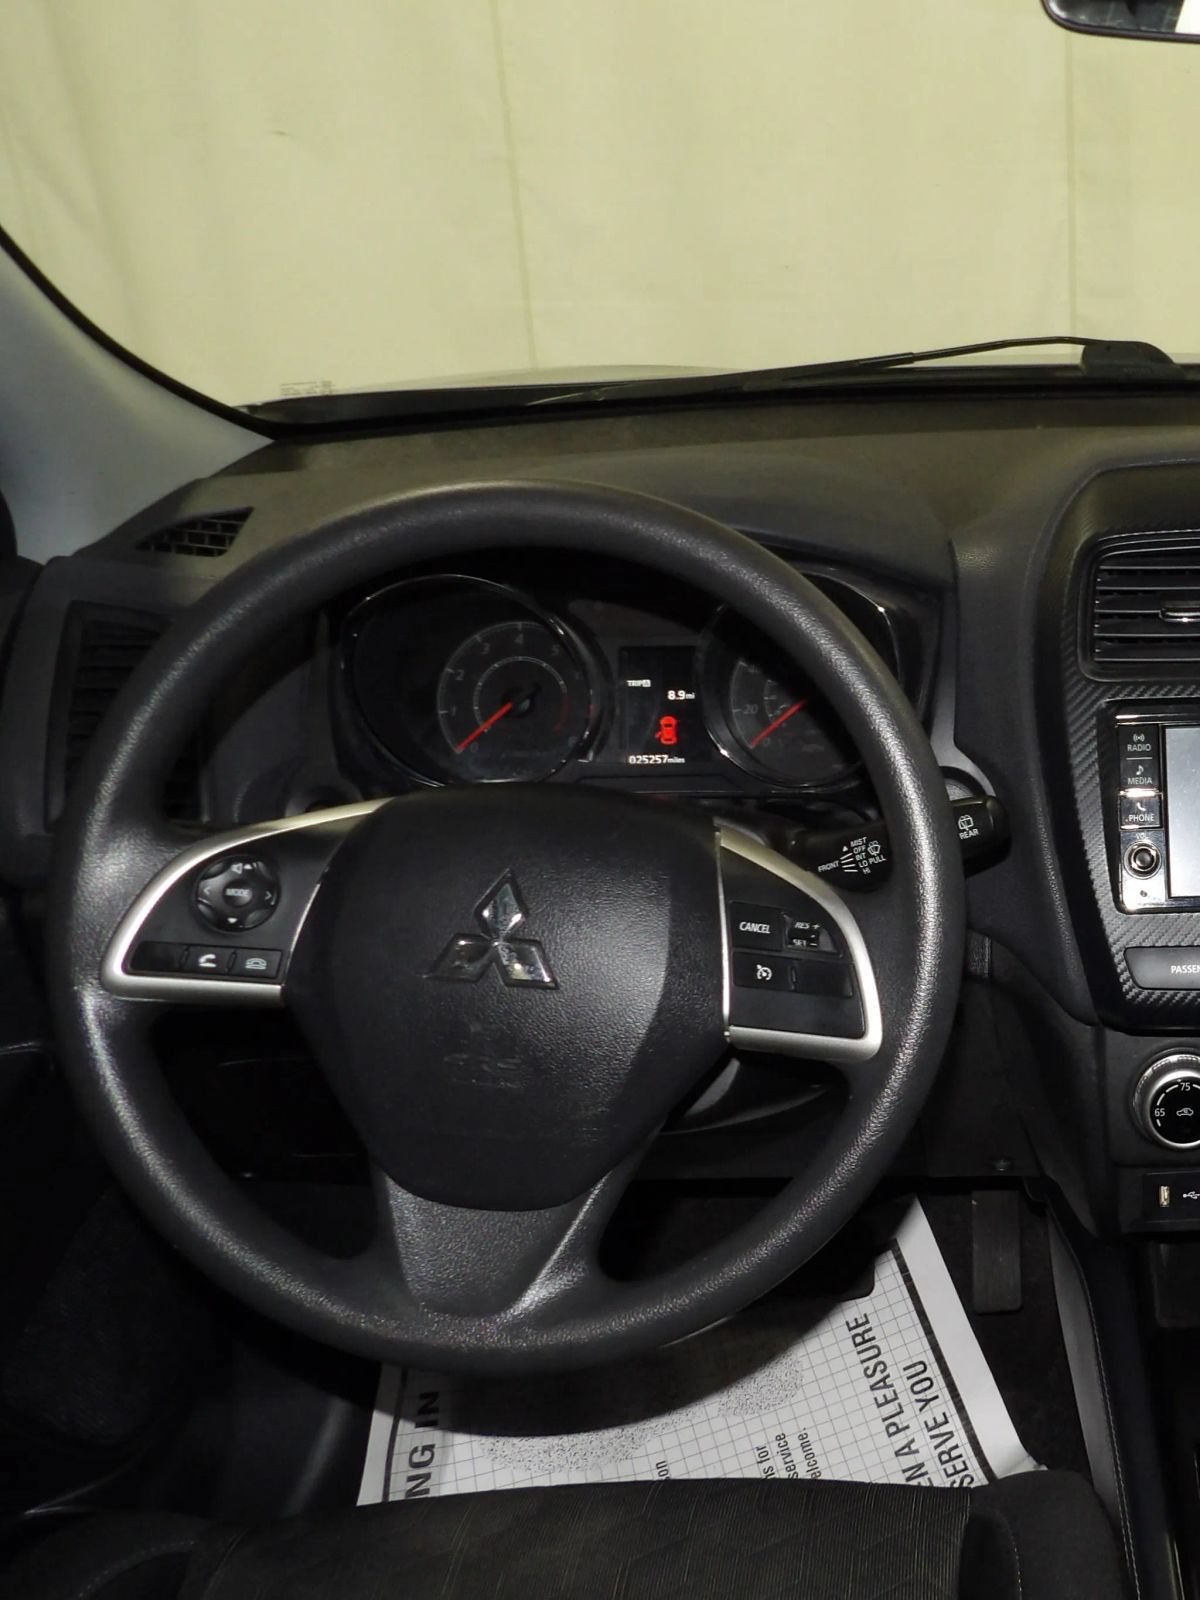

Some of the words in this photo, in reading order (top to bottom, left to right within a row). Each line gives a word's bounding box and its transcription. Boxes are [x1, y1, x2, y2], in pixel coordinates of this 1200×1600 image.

[1127, 744, 1151, 752] RADIO
[1128, 777, 1152, 785] MEDIA
[1129, 814, 1154, 822] PHONE
[959, 829, 979, 840] REAR
[850, 836, 867, 848] MIST
[853, 845, 866, 854] OFF
[855, 852, 866, 861] INT
[858, 860, 868, 868] LO
[868, 854, 887, 865] PULL
[817, 860, 839, 872] FRONT
[225, 888, 250, 897] MODE
[739, 922, 770, 934] CANCEL
[1180, 1082, 1191, 1091] 75
[1154, 1107, 1165, 1117] 65
[846, 1313, 910, 1438] PLEASURE
[903, 1360, 940, 1412] YOU
[894, 1438, 920, 1457] A
[924, 1411, 974, 1488] SERVE
